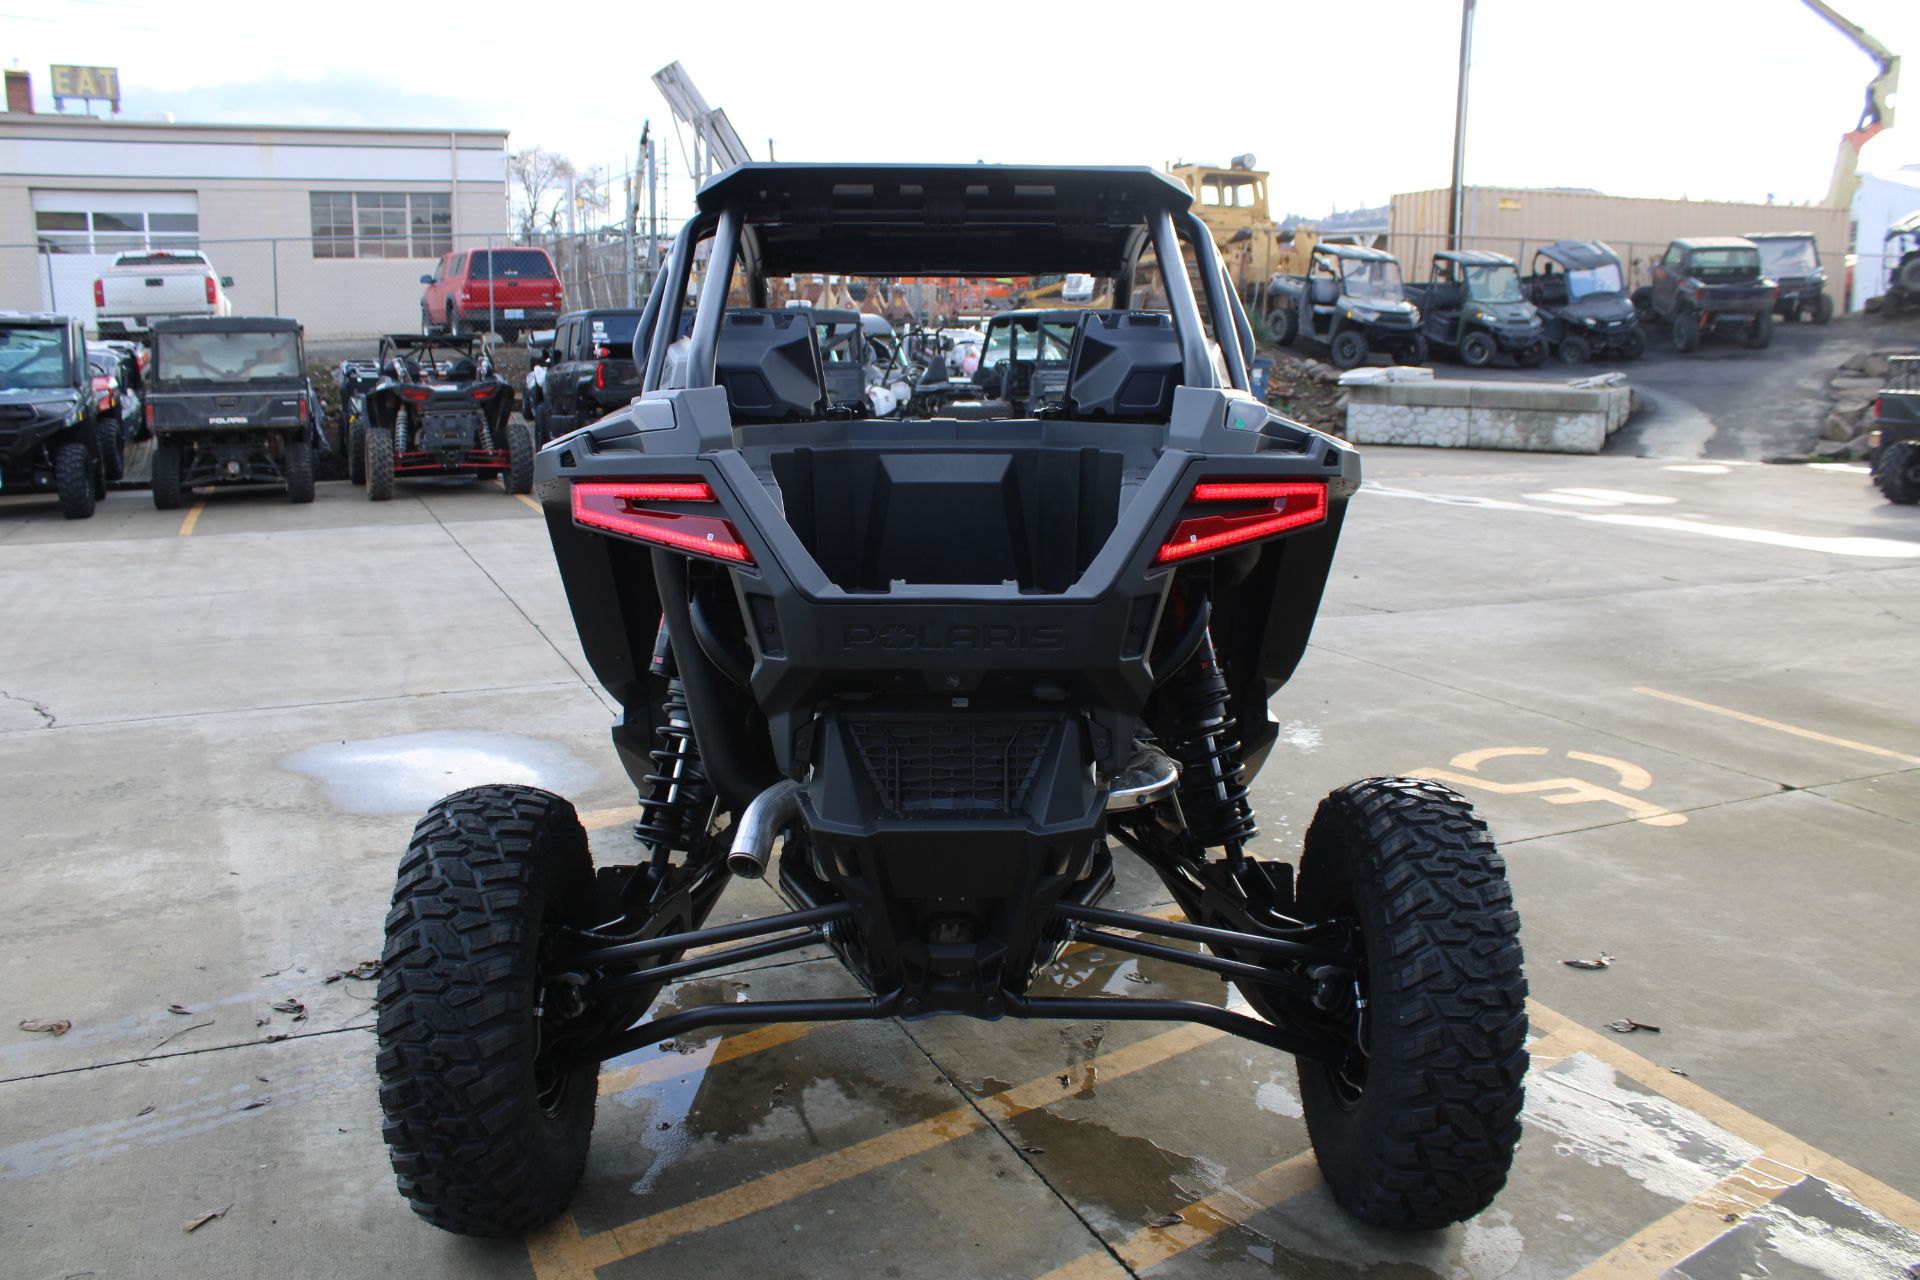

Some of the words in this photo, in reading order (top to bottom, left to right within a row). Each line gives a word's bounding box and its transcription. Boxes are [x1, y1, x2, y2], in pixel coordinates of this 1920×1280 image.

[54, 67, 114, 97] EAT
[208, 416, 249, 425] POLARIS
[842, 623, 1065, 651] POLARIS
